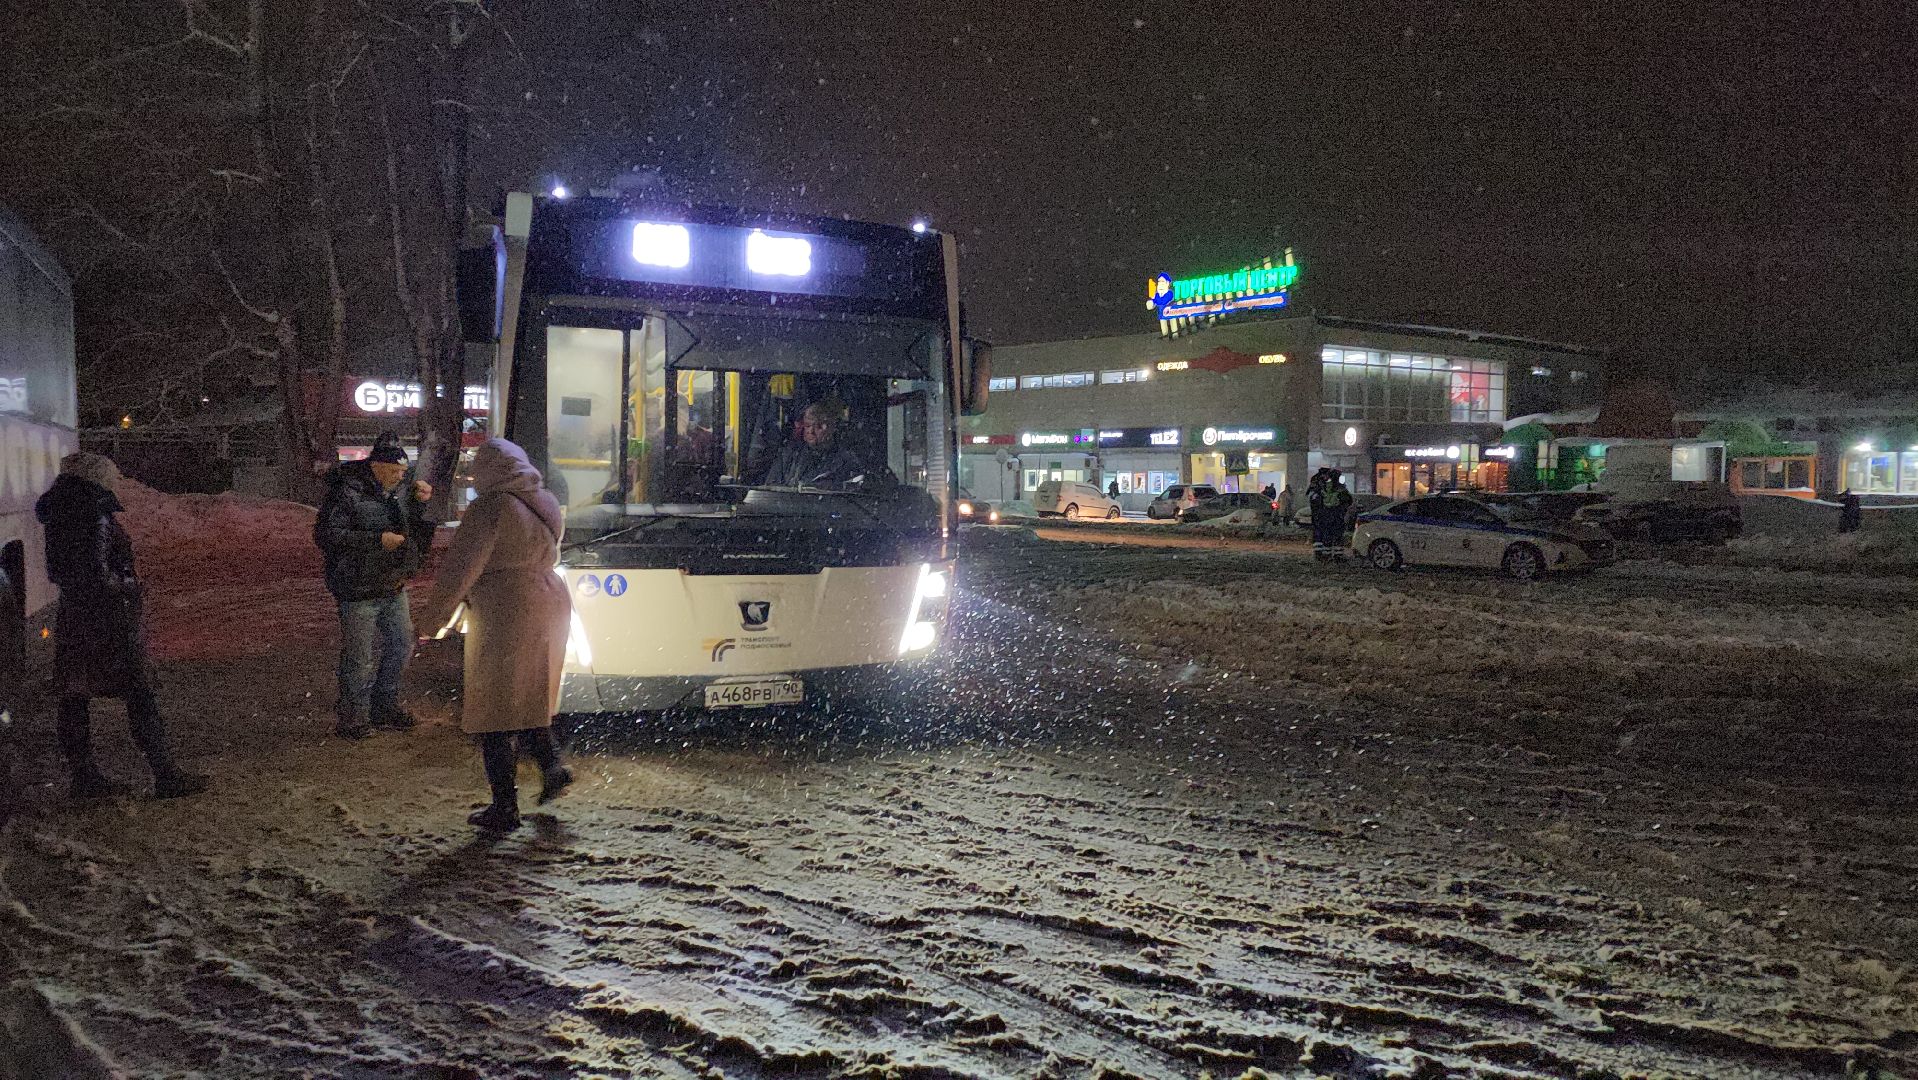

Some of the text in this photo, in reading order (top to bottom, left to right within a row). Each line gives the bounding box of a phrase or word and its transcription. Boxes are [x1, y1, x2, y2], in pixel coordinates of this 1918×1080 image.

[1172, 265, 1298, 301] ТОРГОВЫЙ ЦЕНТР
[1157, 360, 1188, 372] ОДЕЖДА
[1258, 353, 1287, 364] ОБУВЬ
[710, 685, 772, 704] А468РВ
